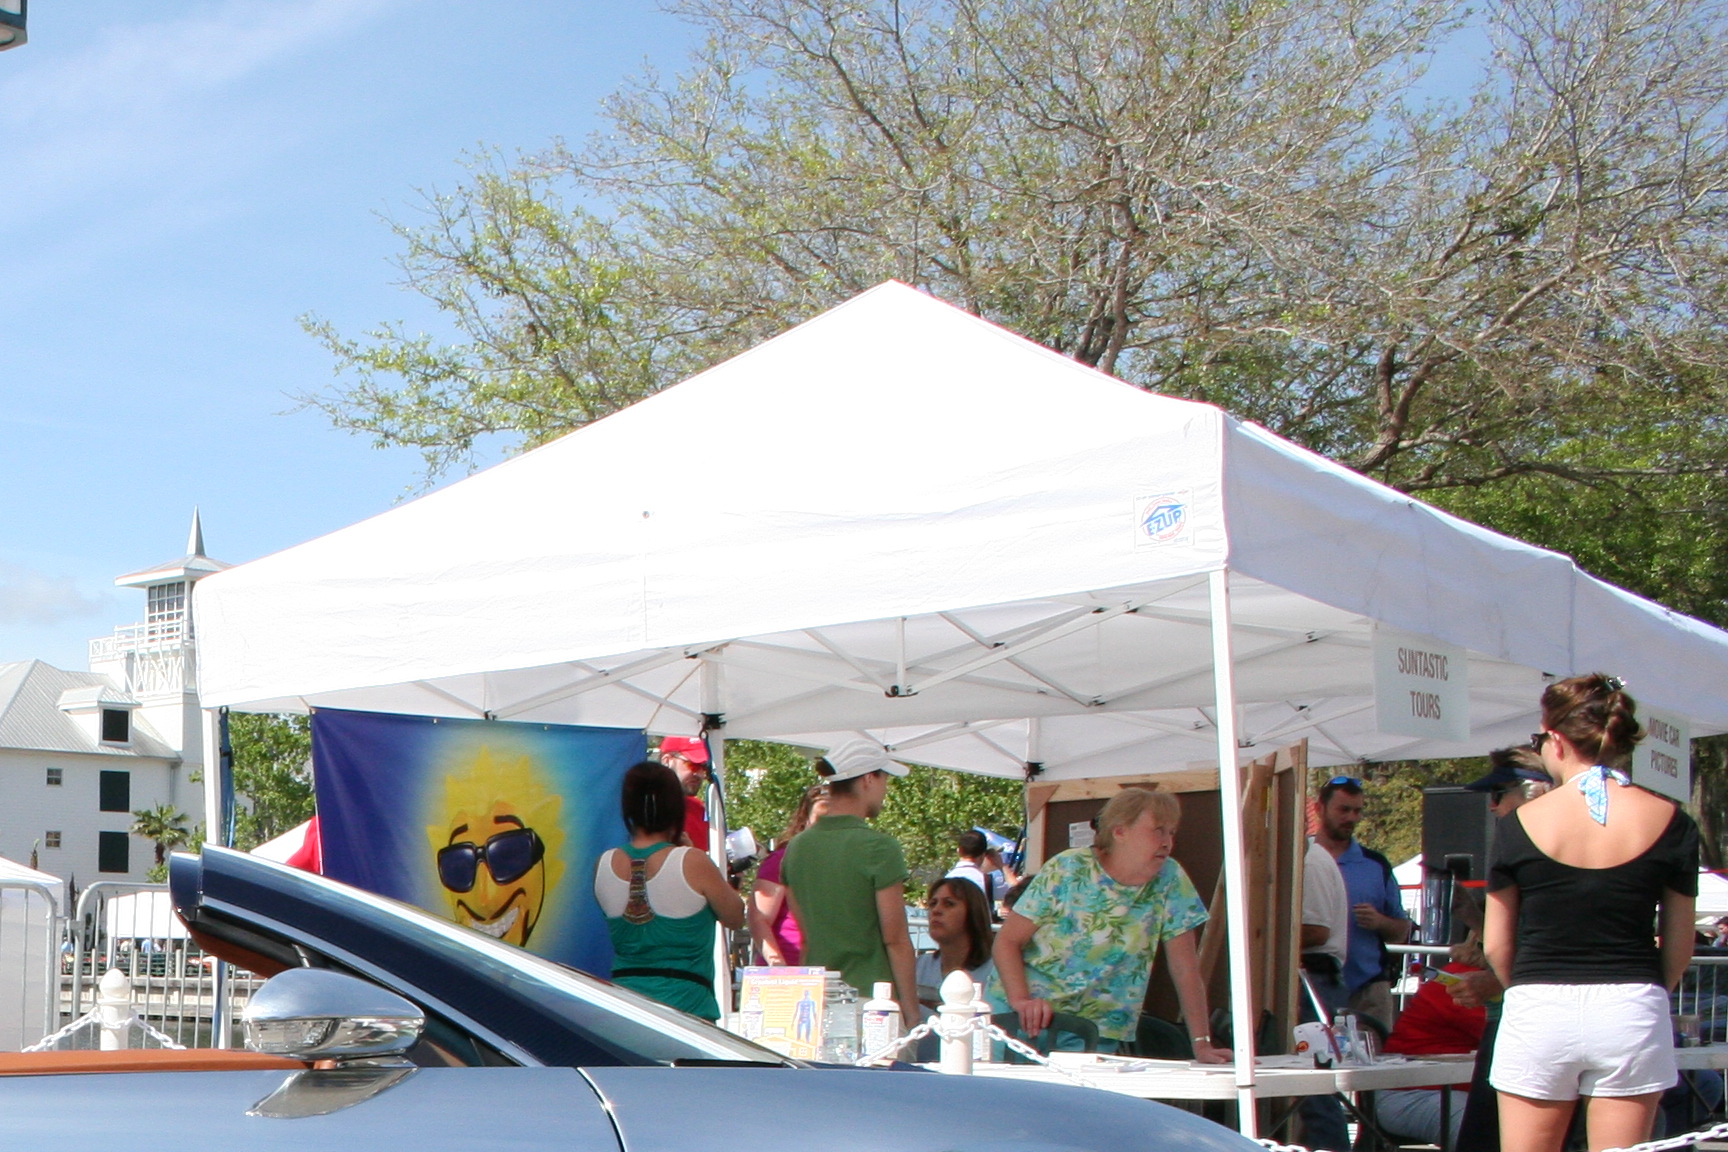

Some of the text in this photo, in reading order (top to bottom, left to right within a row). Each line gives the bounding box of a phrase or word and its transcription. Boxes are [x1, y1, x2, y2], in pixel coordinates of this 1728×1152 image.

[1398, 647, 1449, 681] SUNTASTIC
[1410, 690, 1441, 720] TOURS
[1650, 749, 1678, 779] PICTURES
